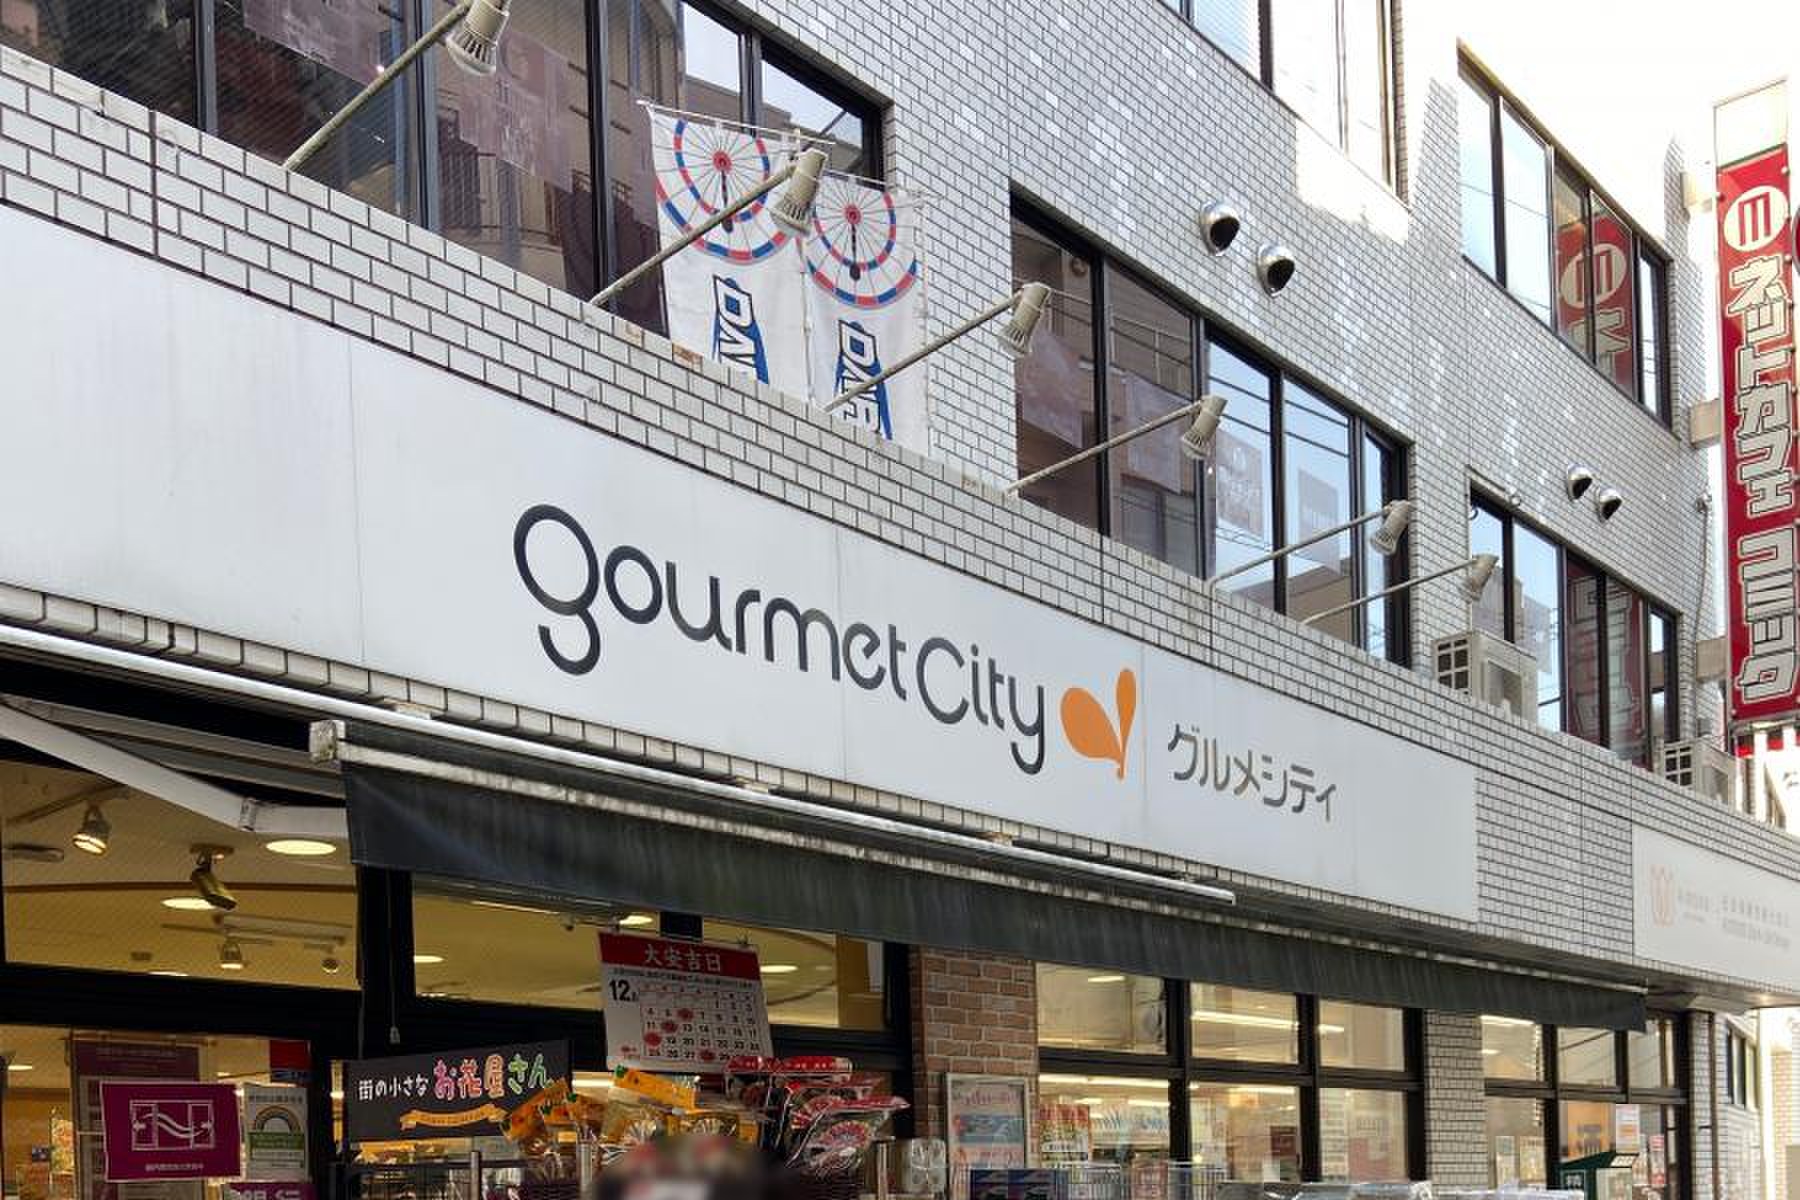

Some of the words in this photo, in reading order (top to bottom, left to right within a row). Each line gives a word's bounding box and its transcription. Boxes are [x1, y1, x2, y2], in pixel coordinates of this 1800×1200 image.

[1726, 254, 1792, 518] ネットカフェ
[1735, 526, 1795, 704] コミック
[1168, 723, 1336, 823] グルメシティ
[644, 944, 721, 971] 大安吉日
